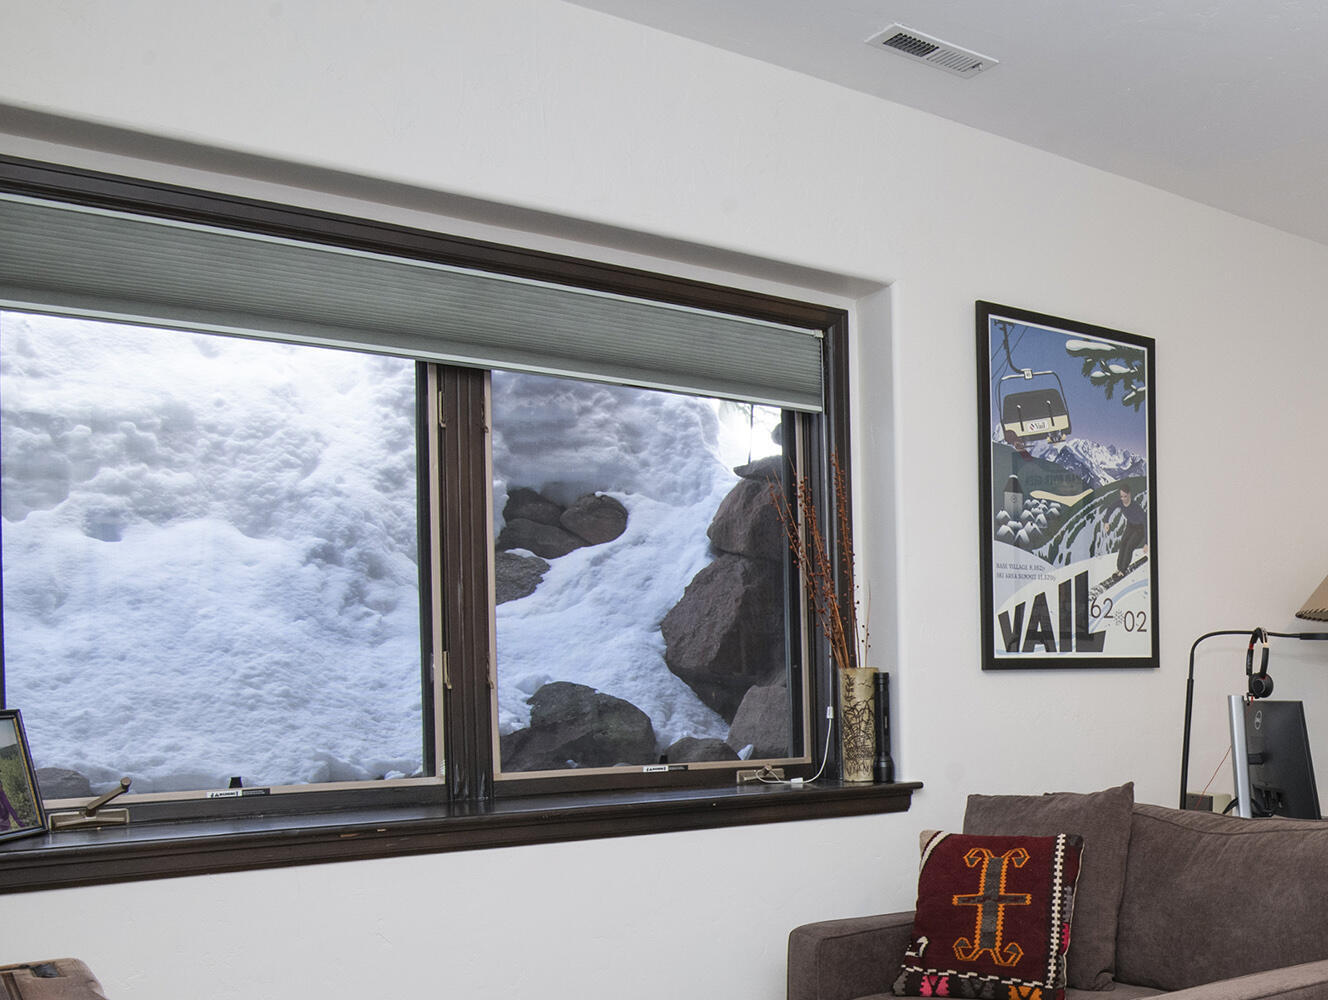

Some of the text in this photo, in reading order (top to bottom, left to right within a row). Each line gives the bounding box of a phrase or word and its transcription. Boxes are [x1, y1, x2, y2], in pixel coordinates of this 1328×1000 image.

[998, 570, 1107, 653] VAIL
[1090, 597, 1148, 633] 62 02
